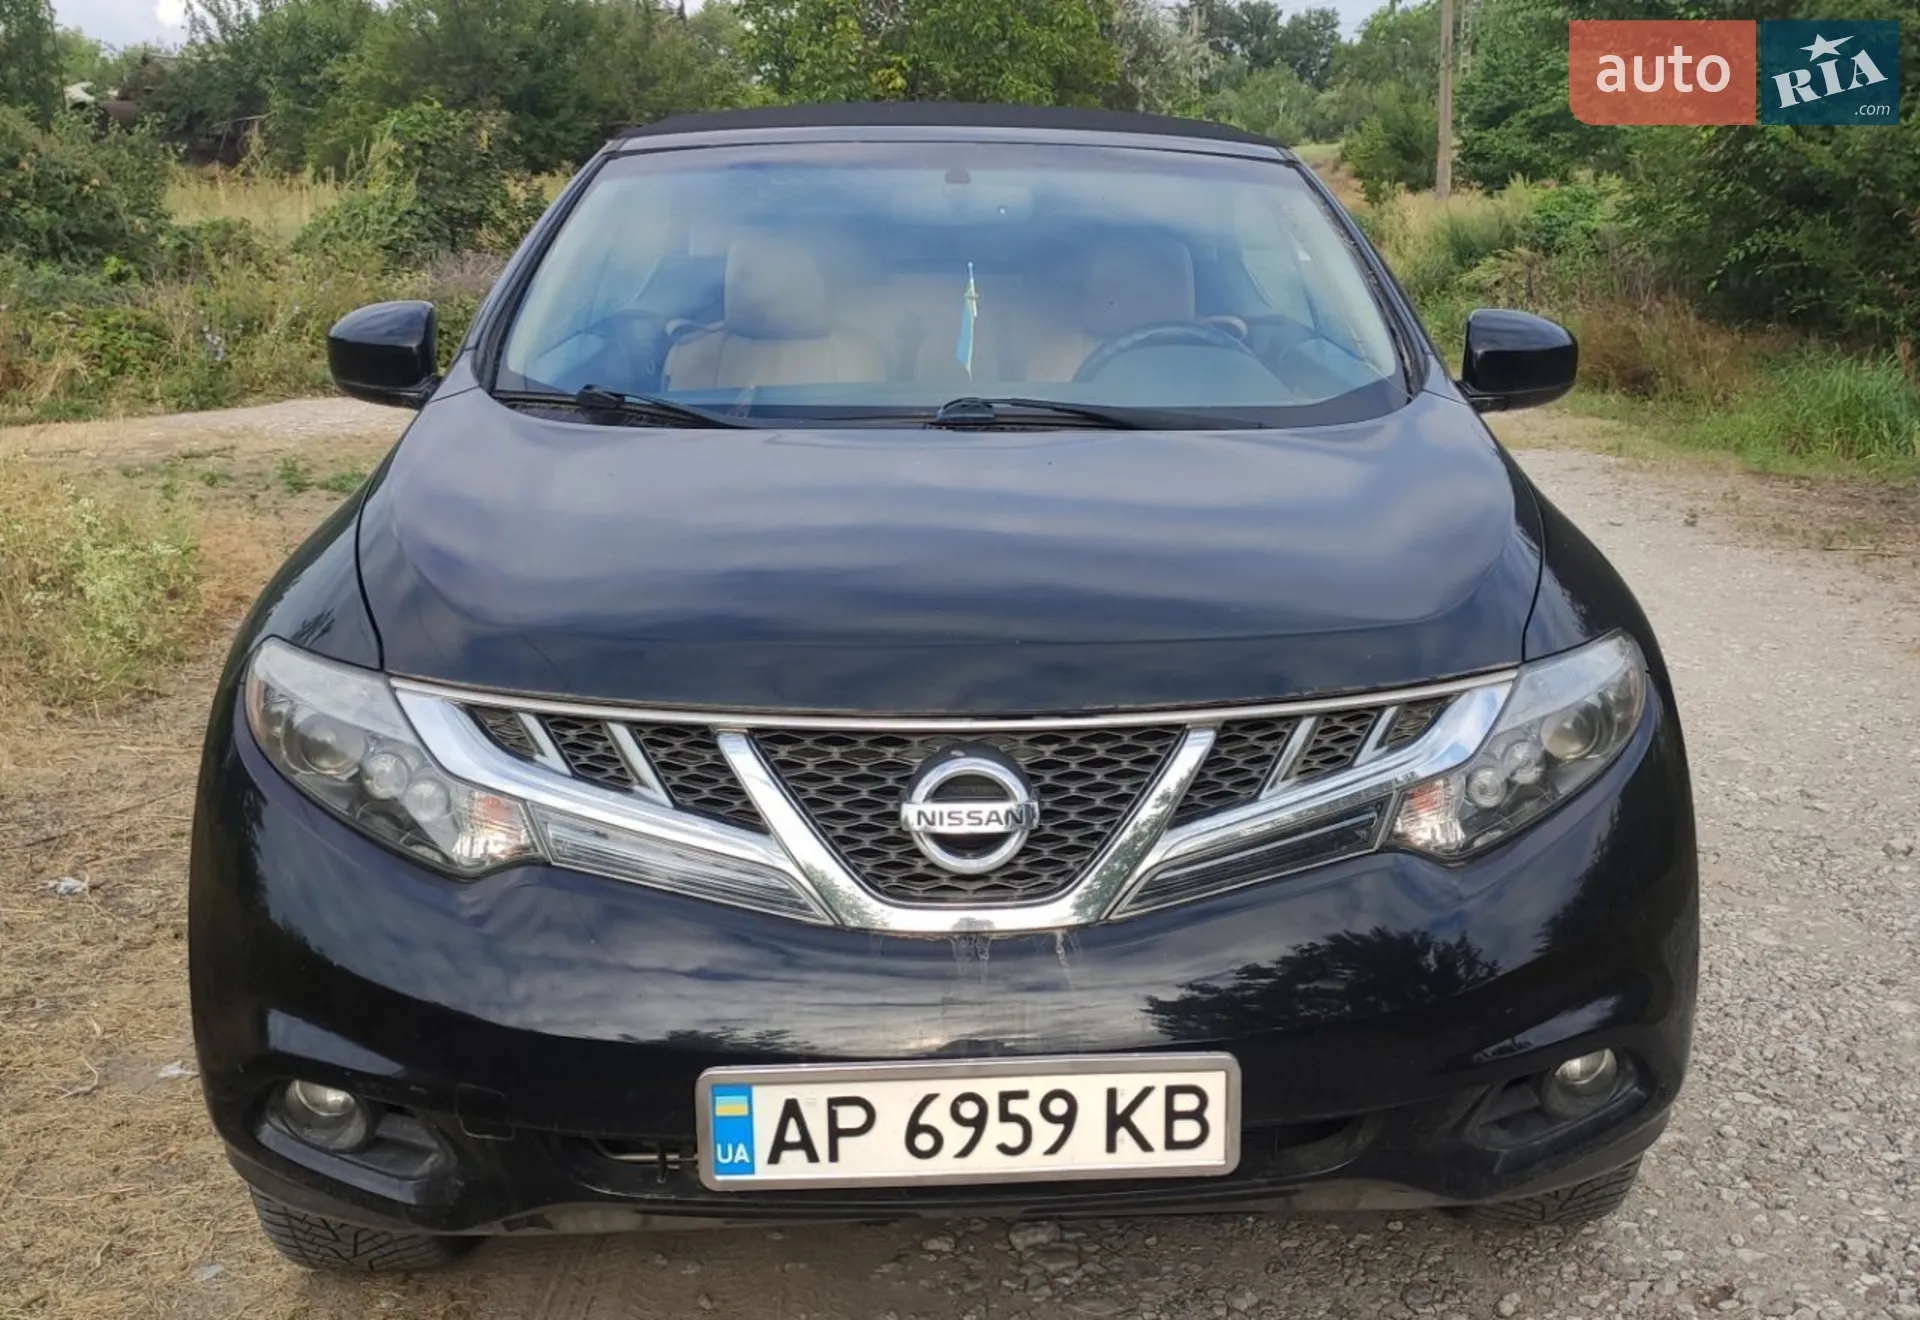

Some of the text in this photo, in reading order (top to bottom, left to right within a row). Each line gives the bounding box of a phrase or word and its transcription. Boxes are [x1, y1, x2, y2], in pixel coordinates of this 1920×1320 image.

[916, 809, 1024, 826] NISSAN
[767, 1084, 1210, 1165] AP 6959 KB
[716, 1143, 750, 1164] UA
